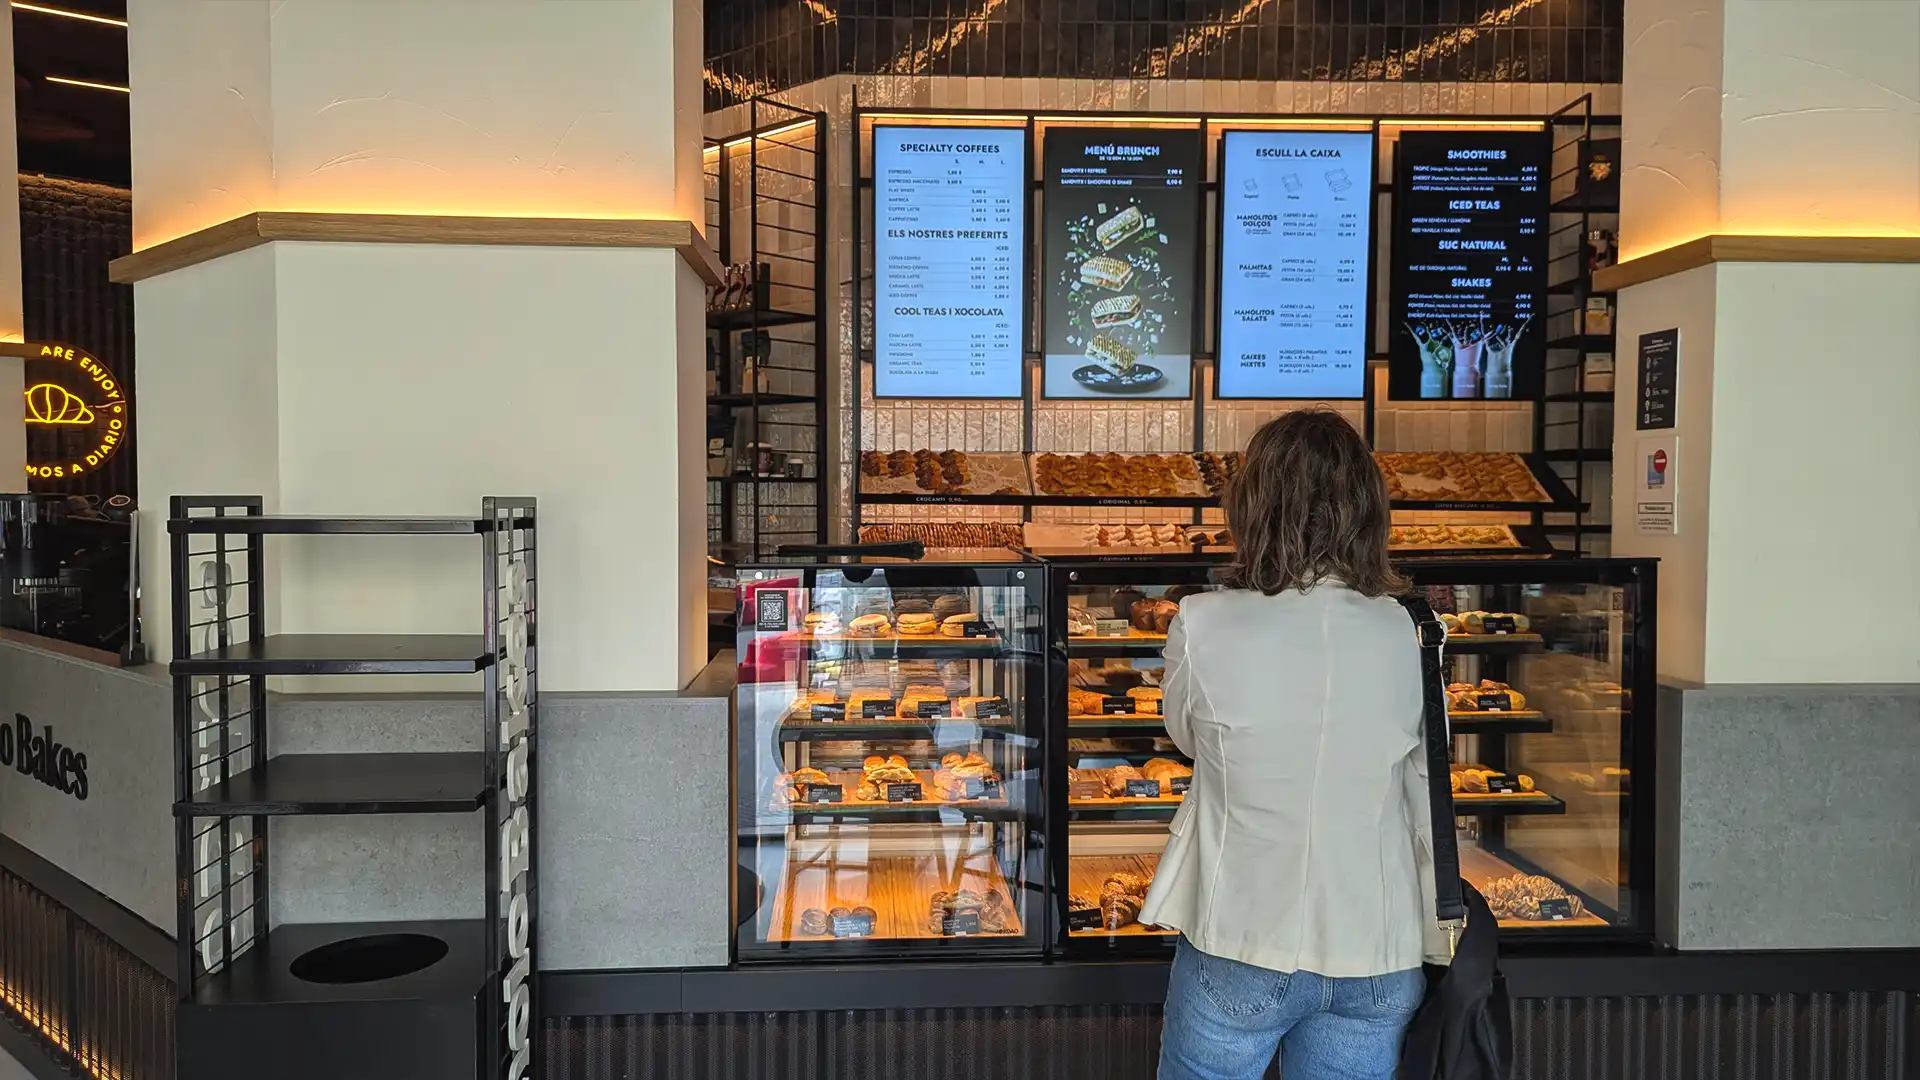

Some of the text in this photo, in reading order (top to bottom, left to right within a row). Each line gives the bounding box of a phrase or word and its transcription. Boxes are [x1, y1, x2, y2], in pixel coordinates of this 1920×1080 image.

[900, 144, 1000, 153] SPECIALTY COFFEES
[1084, 144, 1160, 156] MENÚ BRUNCH
[1256, 149, 1292, 157] ESCULL
[1448, 150, 1506, 160] SMOOTHIES
[1450, 200, 1500, 210] ICED TEAS
[888, 230, 1008, 239] ELS NOSTRES PREFERITS
[1439, 240, 1506, 250] SUC NATURAL
[1452, 278, 1492, 287] SHAKES
[894, 308, 920, 316] COOL
[954, 308, 1004, 316] XOCOLATA
[40, 345, 120, 399] ARE ENJOY
[25, 418, 122, 478] MOS A DIARIO
[501, 560, 529, 892] Bakes
[15, 712, 88, 801] Bakes
